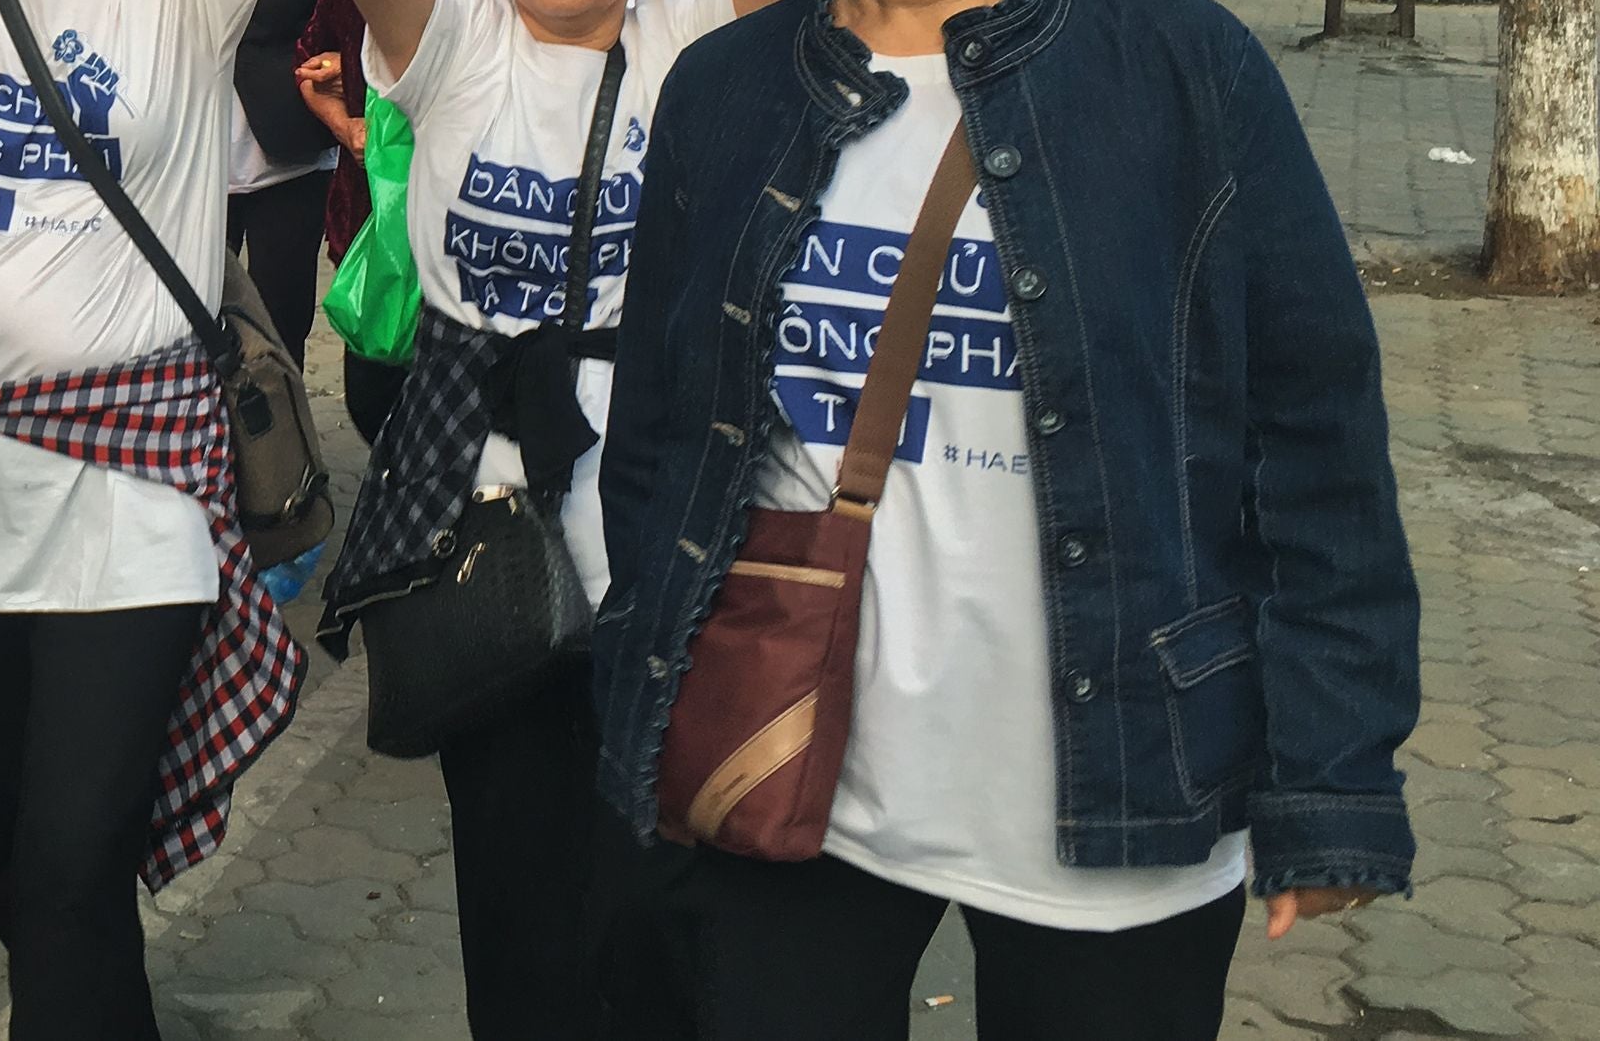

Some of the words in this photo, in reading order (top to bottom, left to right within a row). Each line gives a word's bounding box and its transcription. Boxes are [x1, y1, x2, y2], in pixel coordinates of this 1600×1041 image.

[19, 139, 111, 174] PHI
[467, 167, 555, 213] DÂN
[566, 175, 630, 217] CỦ
[867, 242, 986, 296] CỦ
[943, 442, 1031, 475] #HAE
